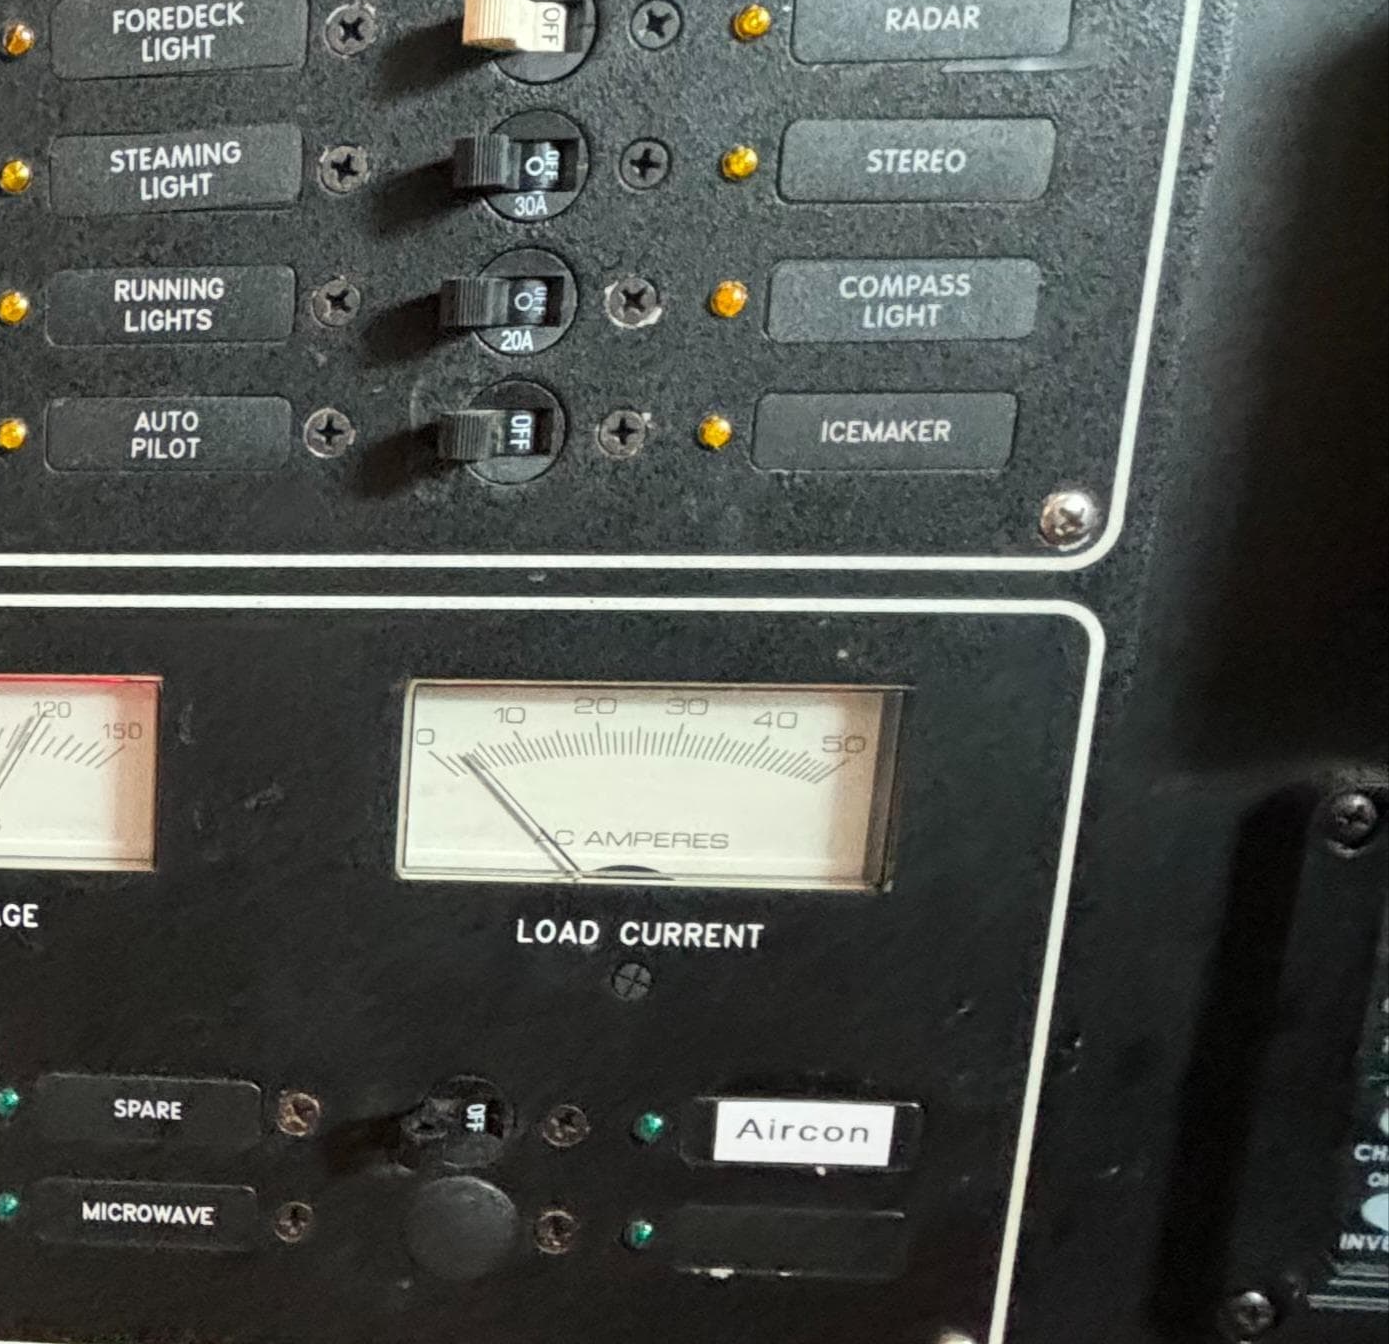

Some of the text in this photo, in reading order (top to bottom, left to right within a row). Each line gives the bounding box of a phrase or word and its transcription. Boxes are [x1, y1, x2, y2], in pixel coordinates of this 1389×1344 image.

[112, 1, 245, 34] FOREDECK
[542, 7, 561, 45] OFF
[885, 4, 981, 32] RADAR
[141, 34, 216, 63] LIGHT
[110, 140, 242, 173] STEAMING
[866, 148, 967, 174] STEREO
[140, 172, 213, 201] LIGHT
[514, 194, 548, 216] 30A
[114, 277, 224, 302] RUNNING
[838, 273, 972, 299] COMPASS
[124, 308, 213, 333] LIGHTS
[863, 303, 942, 329] LIGHT
[501, 330, 533, 351] 20A
[134, 410, 199, 432] AUTO
[510, 414, 533, 450] OFF
[821, 419, 952, 443] ICEMAKER
[130, 437, 201, 459] PILOT
[494, 706, 525, 724] 10
[574, 698, 617, 715] 20
[665, 698, 708, 716] 30
[103, 722, 142, 740] 150
[754, 711, 797, 729] 40
[416, 728, 435, 746] 0
[822, 735, 866, 754] 50
[585, 831, 729, 849] AMPERES
[516, 918, 765, 949] LOAD CURRENT
[114, 1098, 182, 1120] SPARE
[466, 1104, 486, 1132] OFF
[735, 1118, 869, 1143] Aircon
[82, 1201, 214, 1226] MICROWAVE
